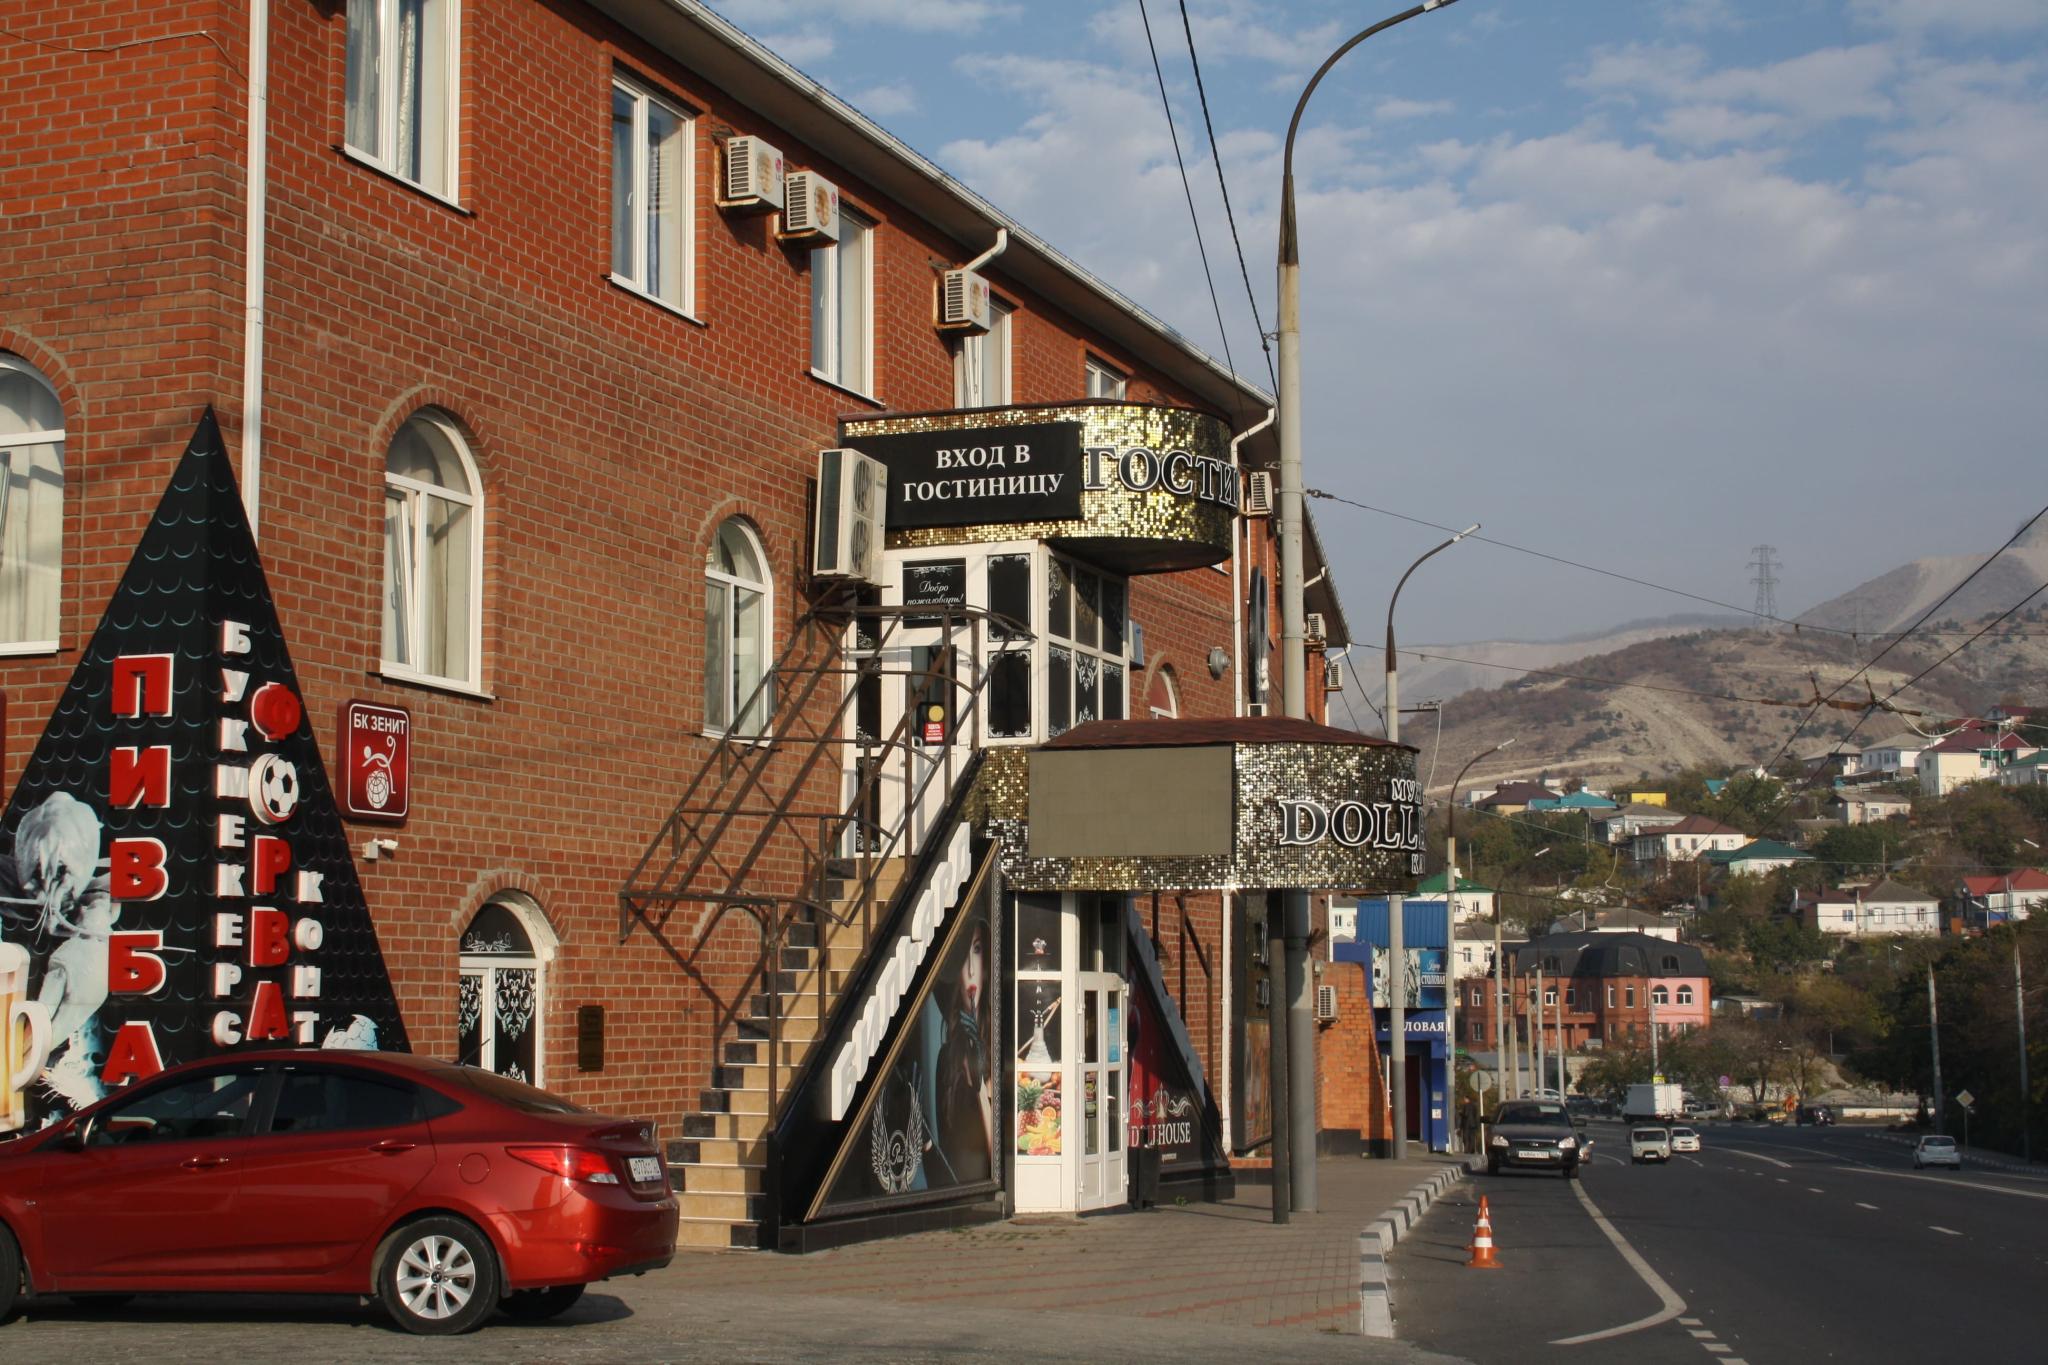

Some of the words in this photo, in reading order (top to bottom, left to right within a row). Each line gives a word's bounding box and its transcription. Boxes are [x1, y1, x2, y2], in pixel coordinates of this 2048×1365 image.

[936, 445, 1005, 469] ВХОД
[1014, 444, 1031, 463] В
[903, 473, 1065, 502] ГОСТИНИЦУ
[919, 580, 949, 594] Добро
[353, 712, 369, 730] БК
[370, 715, 406, 735] ЗЕНИТ
[213, 619, 251, 1117] БУКМЕКЕРС
[101, 653, 175, 1130] ПИВБА
[1381, 1021, 1445, 1032] СЛОВАЯ
